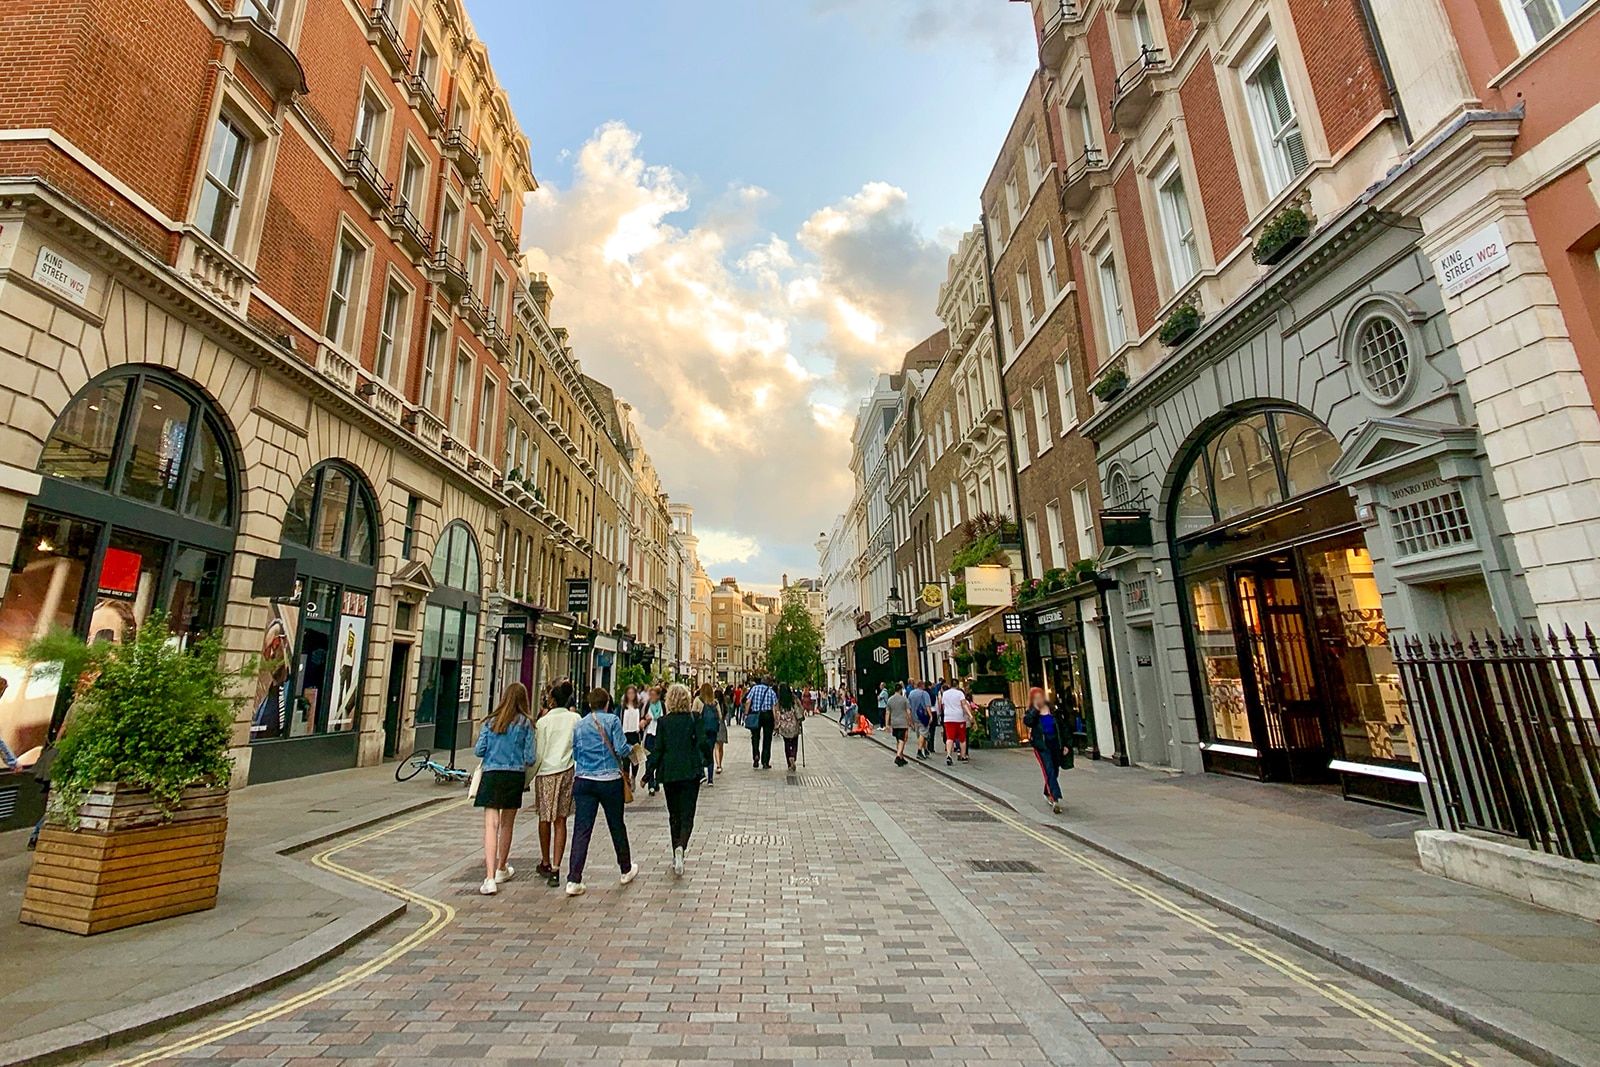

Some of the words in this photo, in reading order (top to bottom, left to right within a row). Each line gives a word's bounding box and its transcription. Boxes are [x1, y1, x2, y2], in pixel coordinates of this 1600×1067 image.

[44, 252, 63, 269] KING
[1441, 250, 1462, 270] KING
[1445, 256, 1475, 282] STREET
[1476, 243, 1498, 262] WC2
[42, 263, 68, 283] STREET
[70, 279, 84, 294] WC2
[1391, 484, 1420, 499] MONRO
